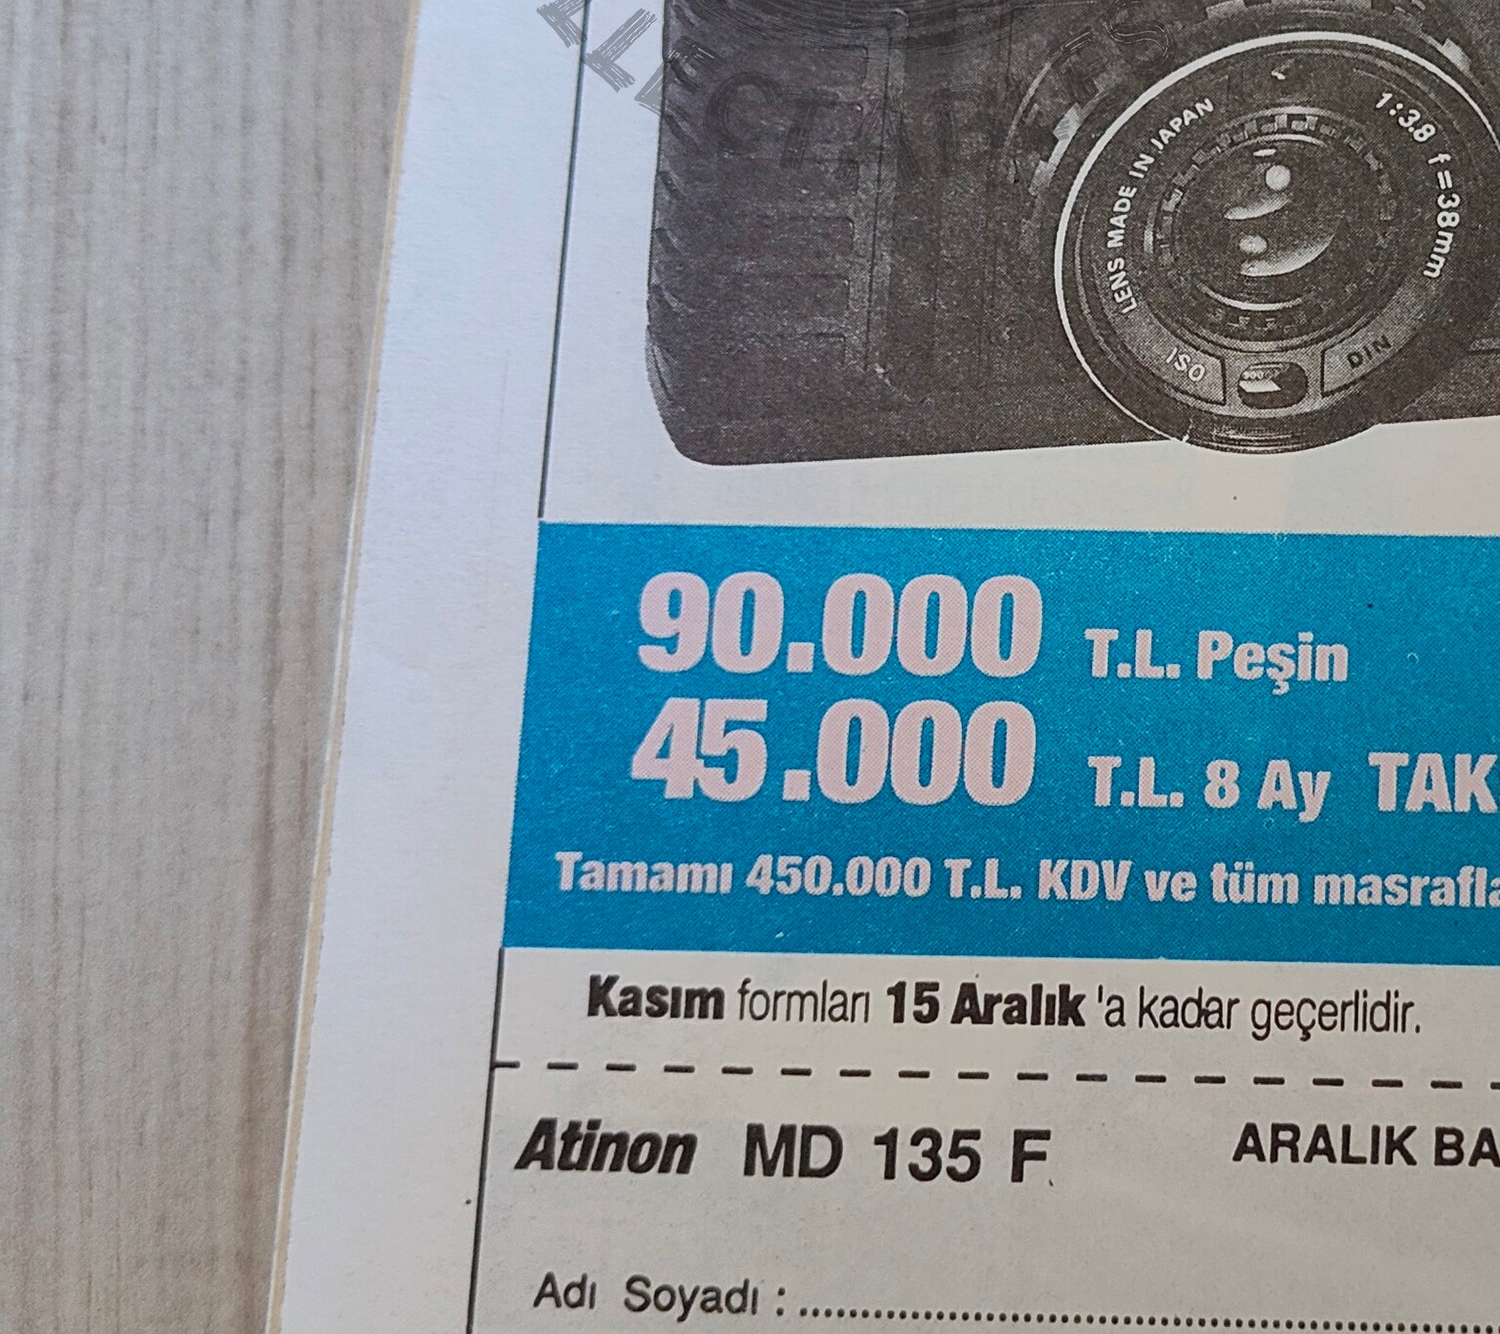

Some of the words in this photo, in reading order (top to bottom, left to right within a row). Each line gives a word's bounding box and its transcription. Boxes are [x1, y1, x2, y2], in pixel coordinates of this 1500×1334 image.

[1151, 98, 1214, 151] JAPAN
[1129, 154, 1155, 179] IN
[1107, 185, 1137, 249] MADE
[1108, 258, 1138, 314] LENS
[1166, 348, 1206, 382] ISO
[1348, 335, 1391, 369] DIN
[638, 571, 1043, 678] 90.000
[1084, 628, 1181, 679] T.L.
[1196, 630, 1349, 695] Peşin
[1087, 755, 1184, 808] T.L.
[1203, 759, 1240, 809] 8
[1257, 759, 1331, 823] Ay
[555, 851, 733, 894] Tamamı
[745, 854, 932, 897] 450.000
[944, 858, 1022, 899] T.L.
[1038, 859, 1132, 901] KDV
[1144, 870, 1197, 902] ve
[1210, 861, 1299, 904] tüm
[587, 974, 725, 1020] Kasım
[737, 977, 870, 1024] formları
[886, 980, 940, 1024] 15
[1138, 985, 1241, 1030] kadar
[1250, 989, 1421, 1043] geçerlidir.
[513, 1118, 698, 1175] Atinon
[743, 1123, 844, 1179] MD
[873, 1127, 982, 1183] 135
[1012, 1129, 1049, 1180] F
[1232, 1122, 1418, 1166] ARALIK
[532, 1272, 597, 1310] Adı
